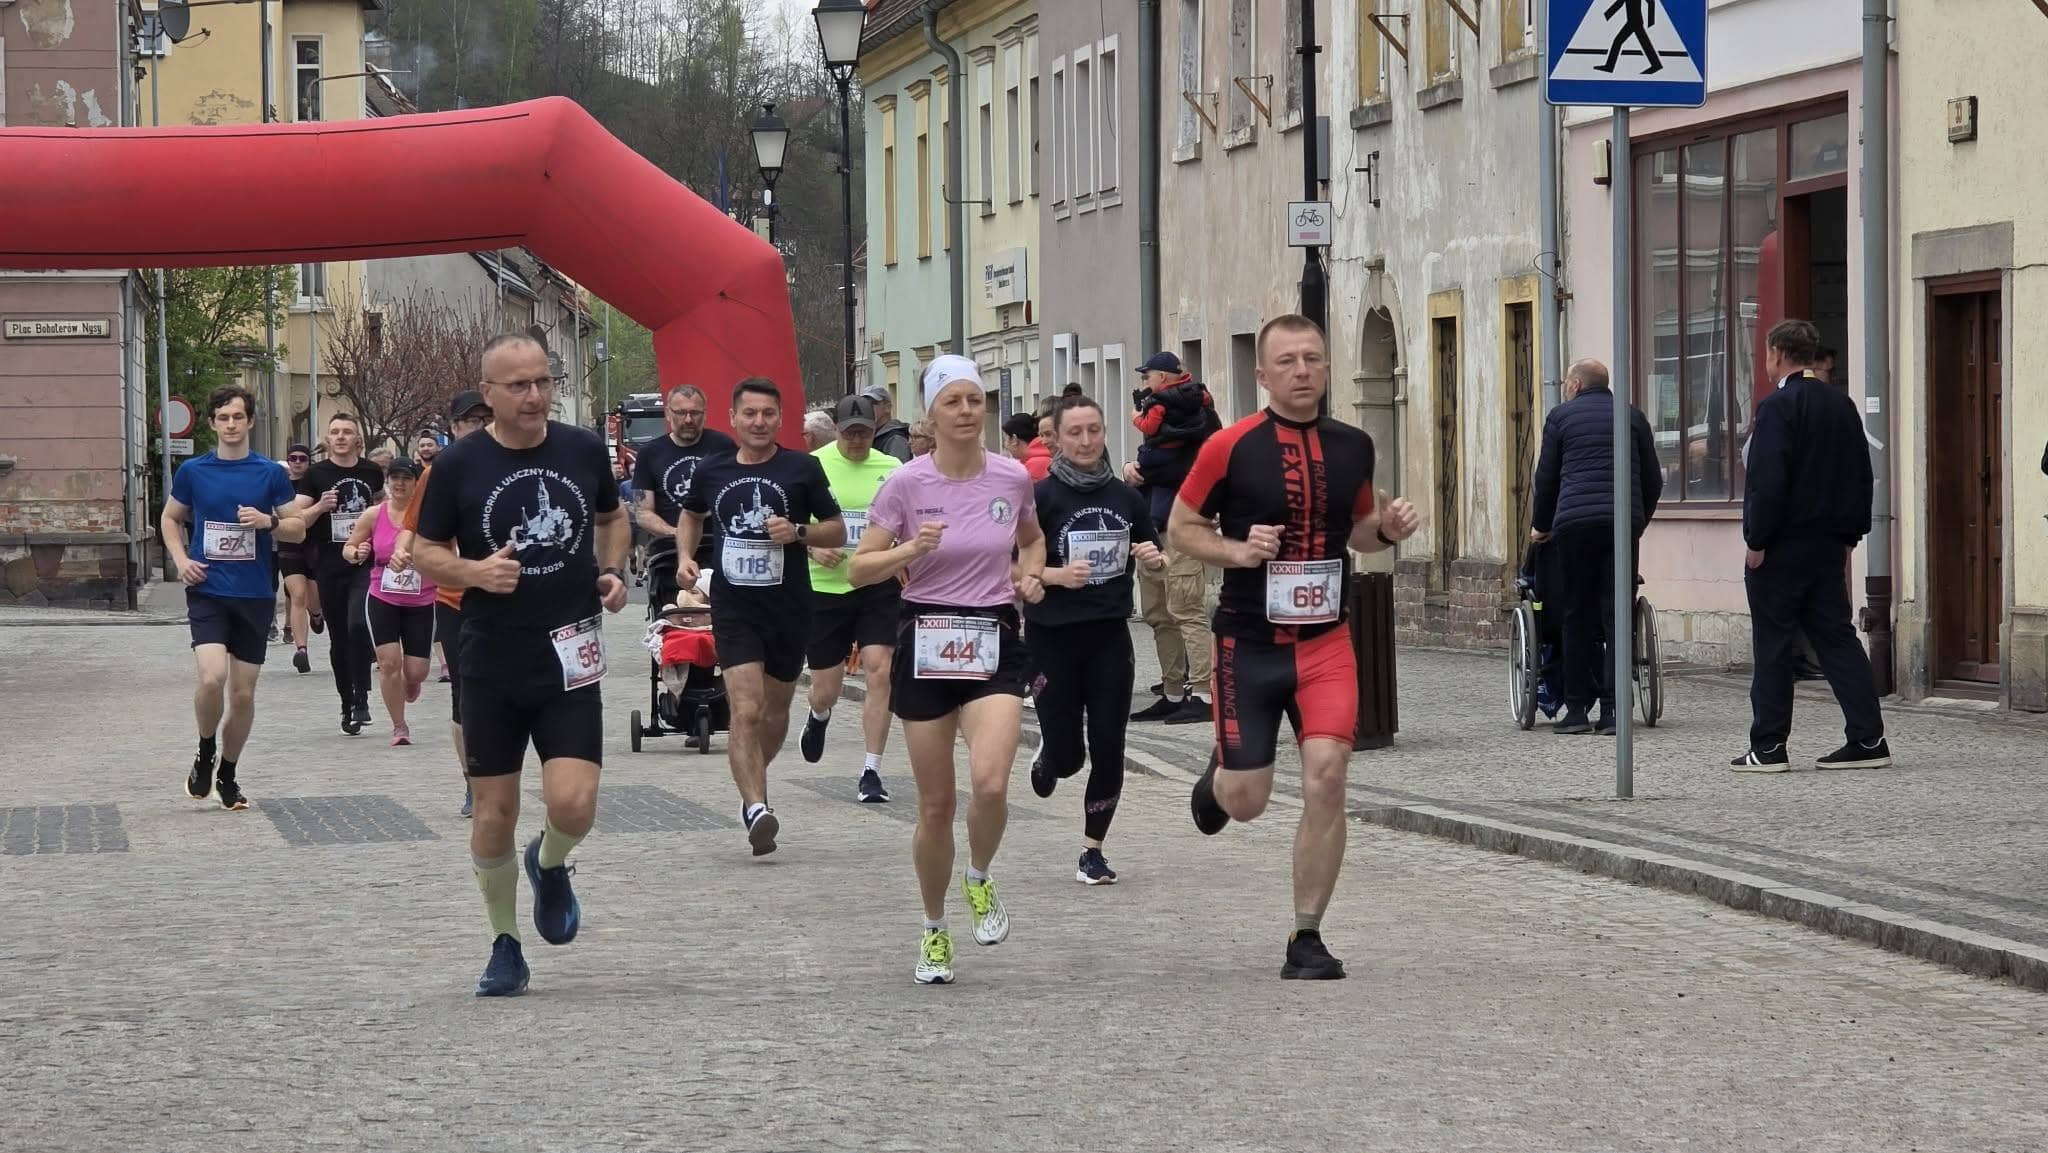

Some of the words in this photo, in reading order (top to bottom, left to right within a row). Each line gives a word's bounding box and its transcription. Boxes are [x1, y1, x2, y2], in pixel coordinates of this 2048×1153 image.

[12, 323, 32, 334] Plac
[82, 322, 102, 335] Nysy
[501, 467, 545, 486] ULICZNY
[1312, 463, 1328, 529] RUNNING
[219, 537, 240, 551] 27
[542, 560, 565, 575] 2026
[736, 557, 767, 574] 118
[1088, 550, 1114, 568] 94
[1271, 564, 1301, 574] XXXIII
[393, 574, 411, 586] 47
[1293, 585, 1324, 608] 68
[577, 641, 602, 668] 58
[939, 640, 977, 663] 44
[1222, 646, 1238, 720] RUNNING
